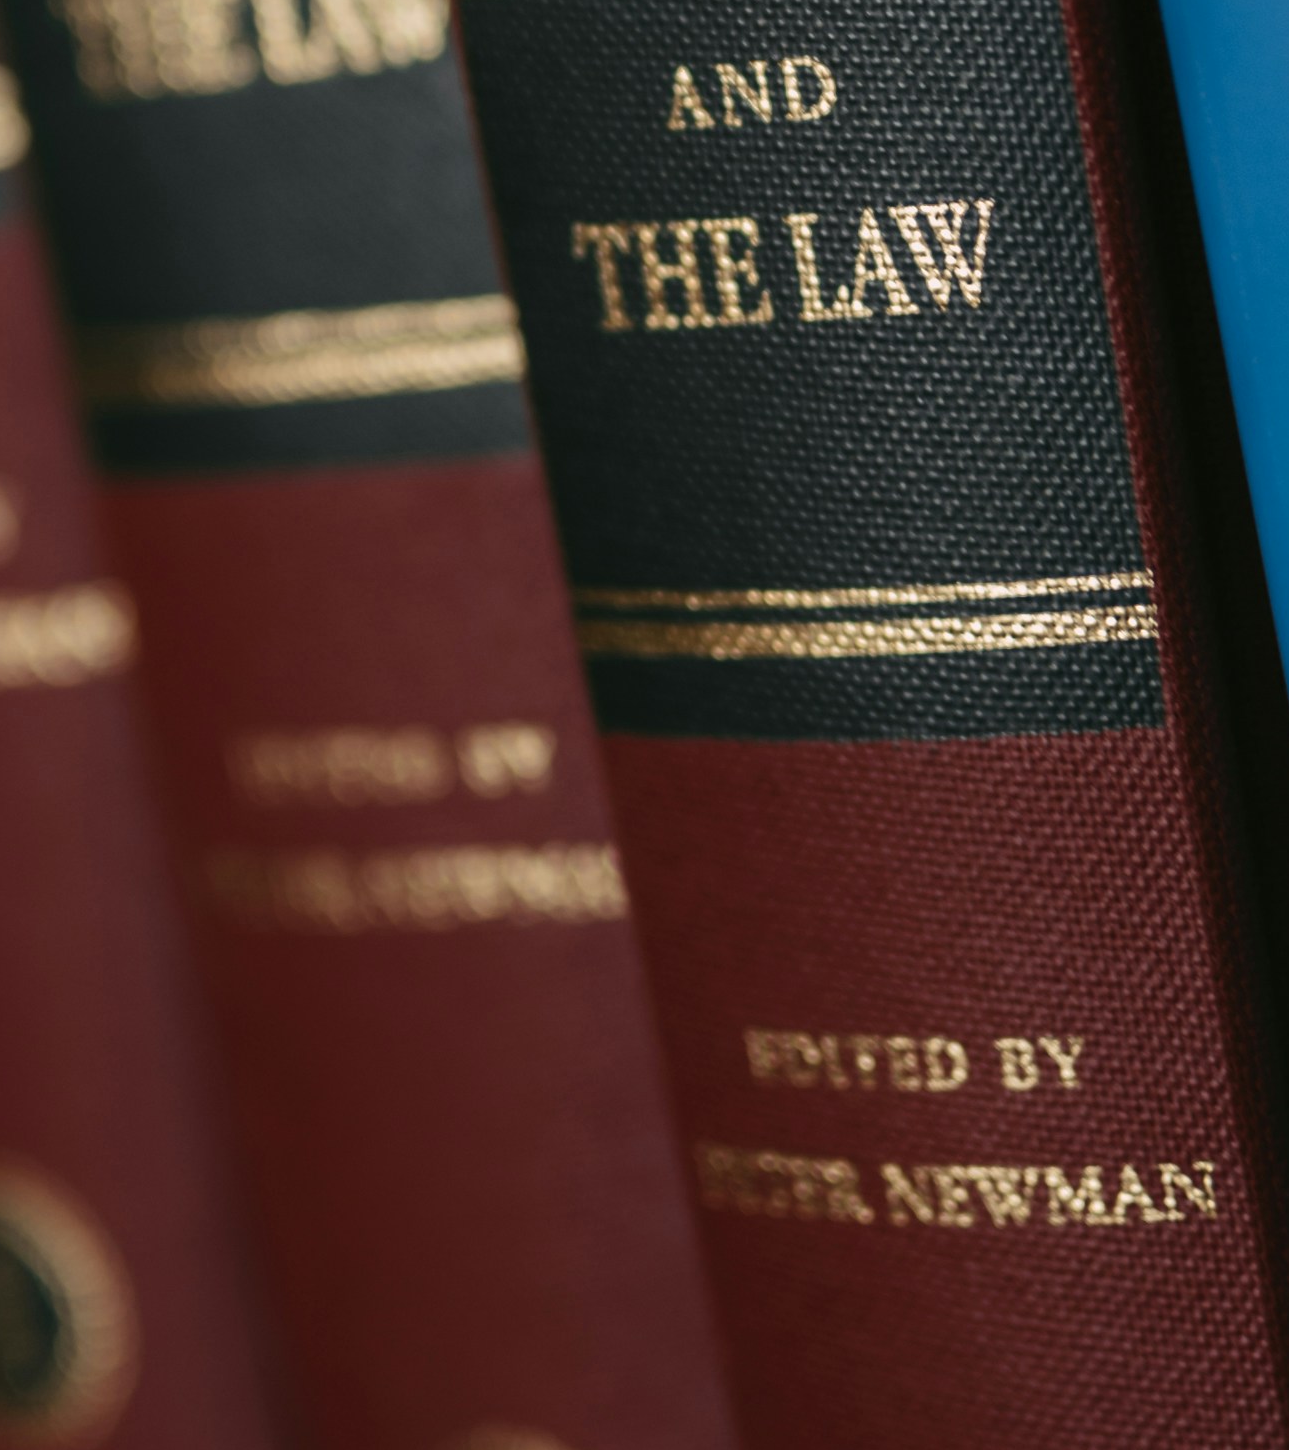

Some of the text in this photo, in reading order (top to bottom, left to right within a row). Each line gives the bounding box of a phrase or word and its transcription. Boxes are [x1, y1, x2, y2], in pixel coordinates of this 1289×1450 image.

[667, 54, 838, 132] AND
[572, 197, 996, 333] THE LAW
[994, 1035, 1085, 1091] BY
[881, 1160, 1216, 1229] NEWMAN
